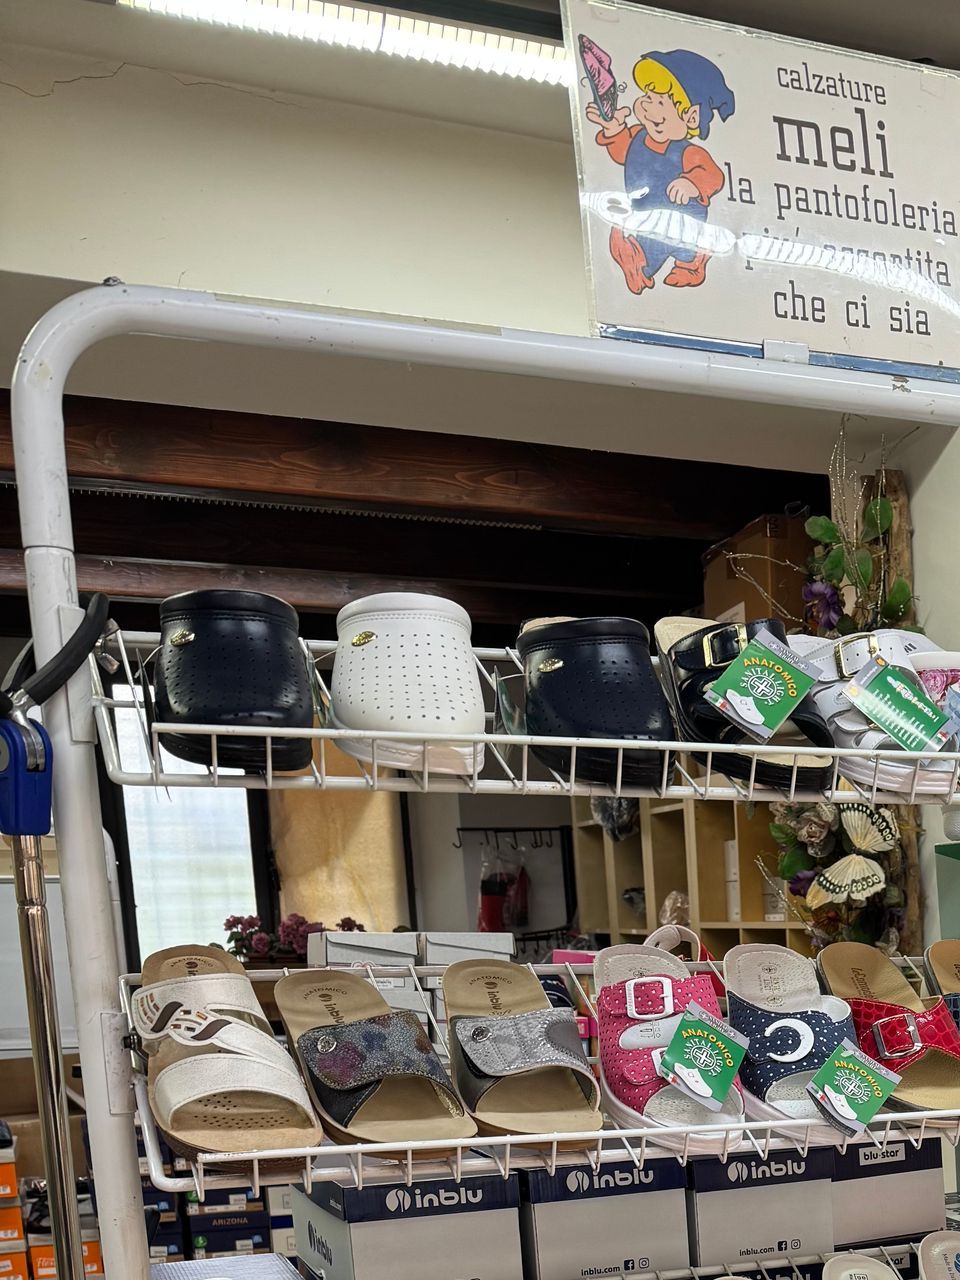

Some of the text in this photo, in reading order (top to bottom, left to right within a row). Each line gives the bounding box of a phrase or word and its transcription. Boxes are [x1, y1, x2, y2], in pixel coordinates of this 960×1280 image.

[777, 62, 887, 105] calzature
[772, 108, 894, 179] meli
[724, 162, 958, 237] la pantofoleria
[774, 280, 931, 336] che ci sia
[743, 657, 797, 697] ANATOMICO
[469, 976, 513, 985] ANATOMICO
[681, 1029, 734, 1068] ANATOMICO
[685, 1037, 712, 1059] SANITAL
[833, 1068, 863, 1088] SANITAL
[834, 1060, 883, 1099] ANATOMICO
[593, 1168, 654, 1190] inblu
[751, 1160, 806, 1179] inblu
[415, 1187, 483, 1208] inblu
[212, 1217, 248, 1226] ARIZONA
[314, 1229, 333, 1266] inblu
[739, 1246, 775, 1257] inblu.com
[581, 1266, 620, 1277] inblu.com
